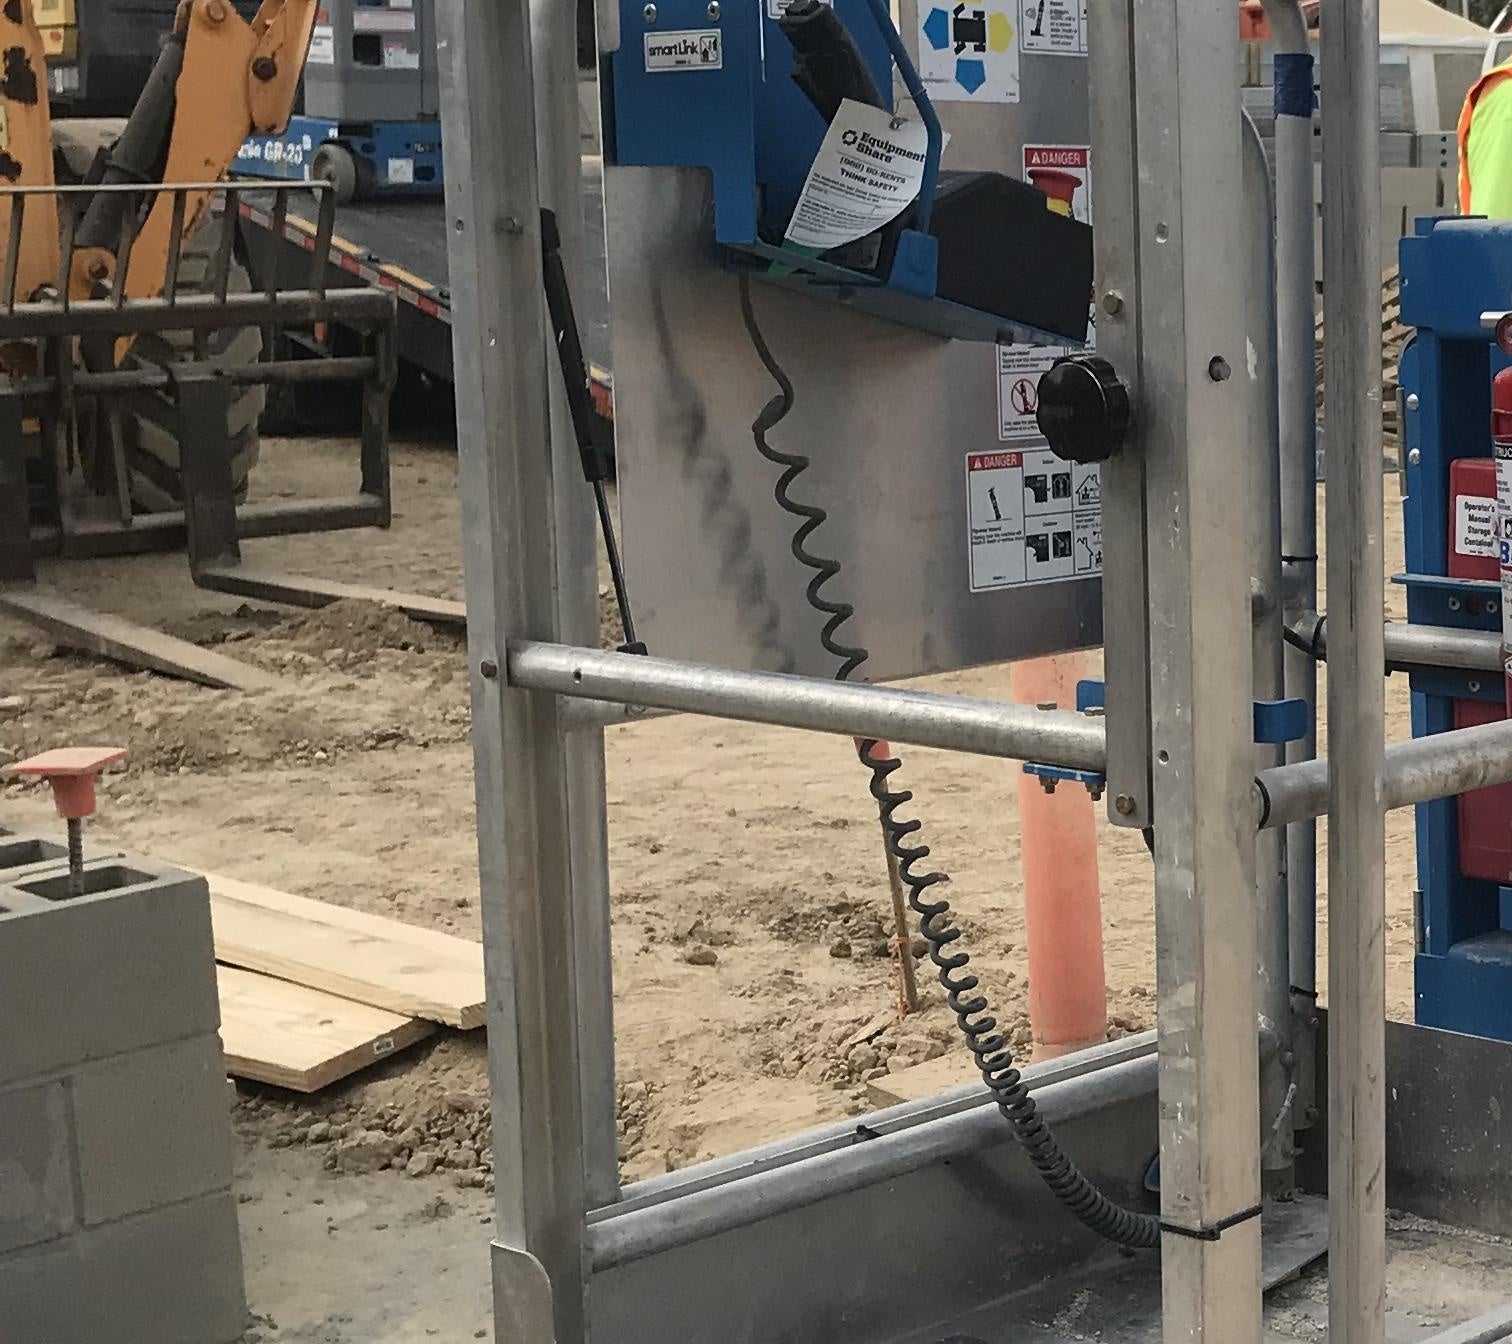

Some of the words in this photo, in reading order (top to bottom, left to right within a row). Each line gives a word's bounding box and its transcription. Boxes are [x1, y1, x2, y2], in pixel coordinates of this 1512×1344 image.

[856, 143, 892, 163] Share
[860, 132, 925, 163] Equipment
[1041, 152, 1081, 165] DANGER
[840, 168, 867, 184] THINK
[868, 178, 898, 193] SAFETY
[984, 454, 1017, 468] DANGER
[1464, 501, 1495, 512] Operator's
[1468, 514, 1491, 524] Manual
[1468, 526, 1491, 537] Storage
